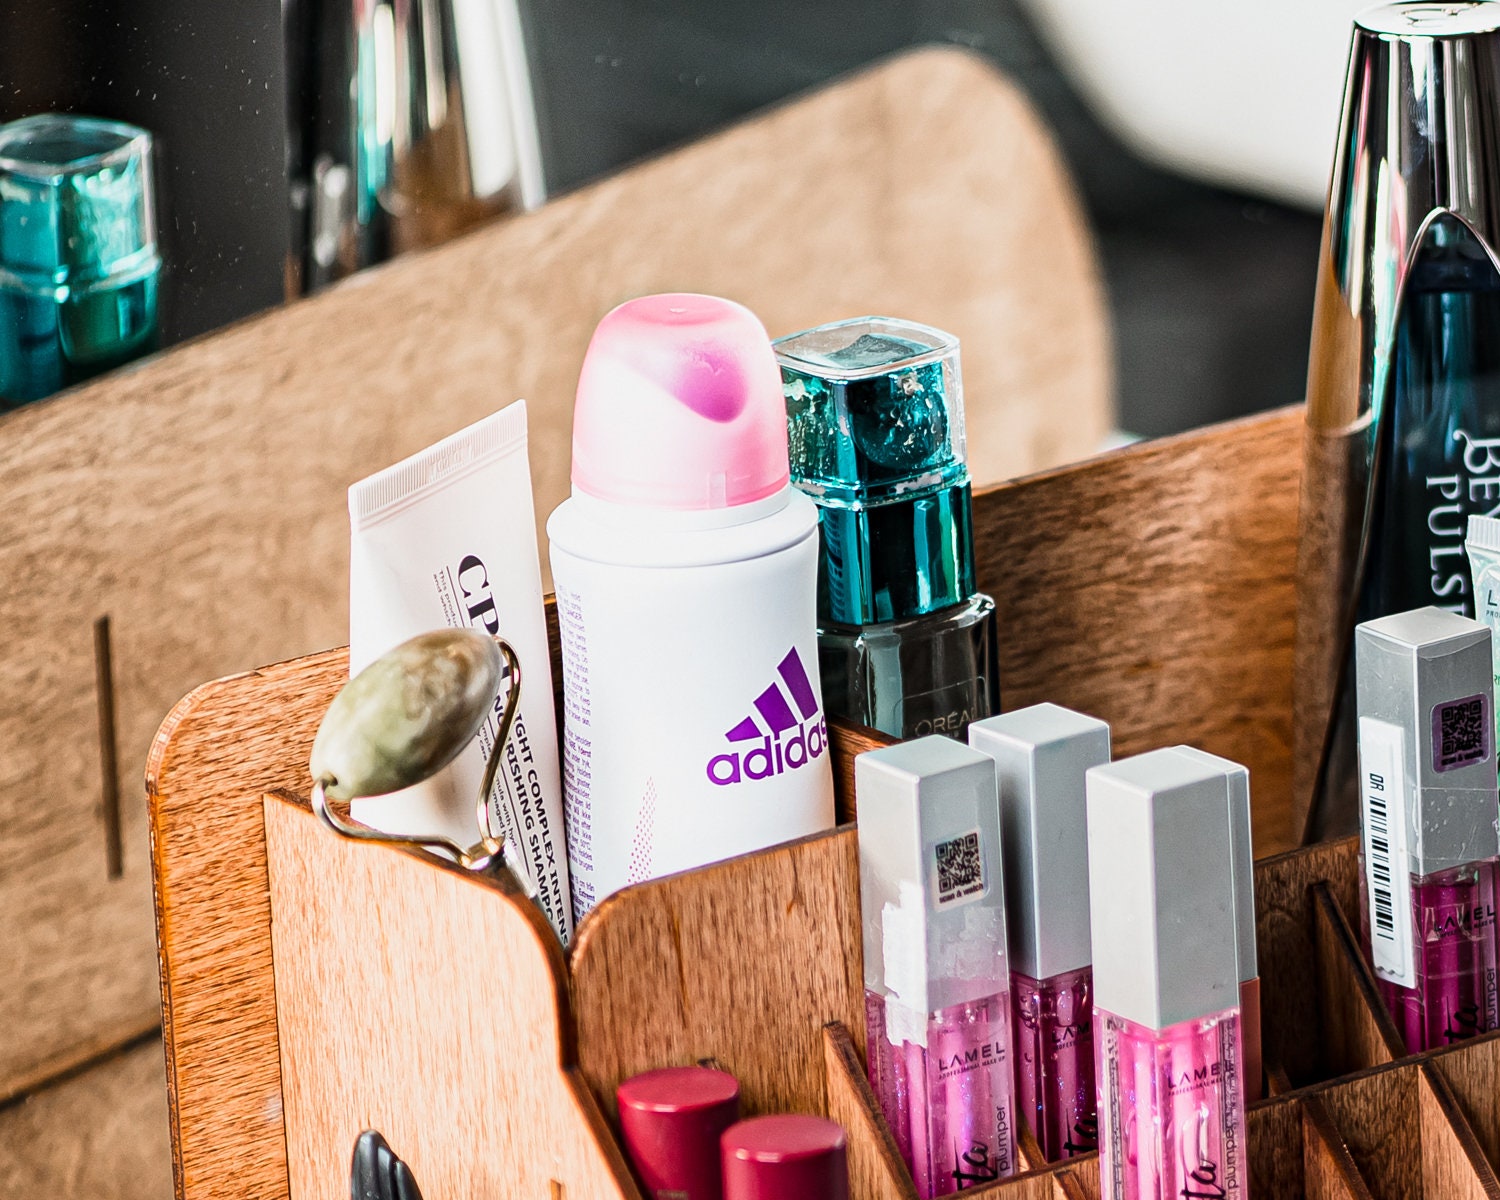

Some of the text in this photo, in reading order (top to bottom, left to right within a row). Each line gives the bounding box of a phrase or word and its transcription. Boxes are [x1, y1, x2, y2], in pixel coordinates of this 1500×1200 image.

[492, 694, 535, 832] NORISHING
[706, 715, 828, 786] adidas
[514, 713, 534, 766] IGHT
[527, 768, 556, 869] COMPLEX
[1052, 1020, 1090, 1044] LAM
[1485, 967, 1498, 1031] plumper
[938, 1041, 1006, 1072] LAMEL
[995, 1105, 1010, 1172] plumper
